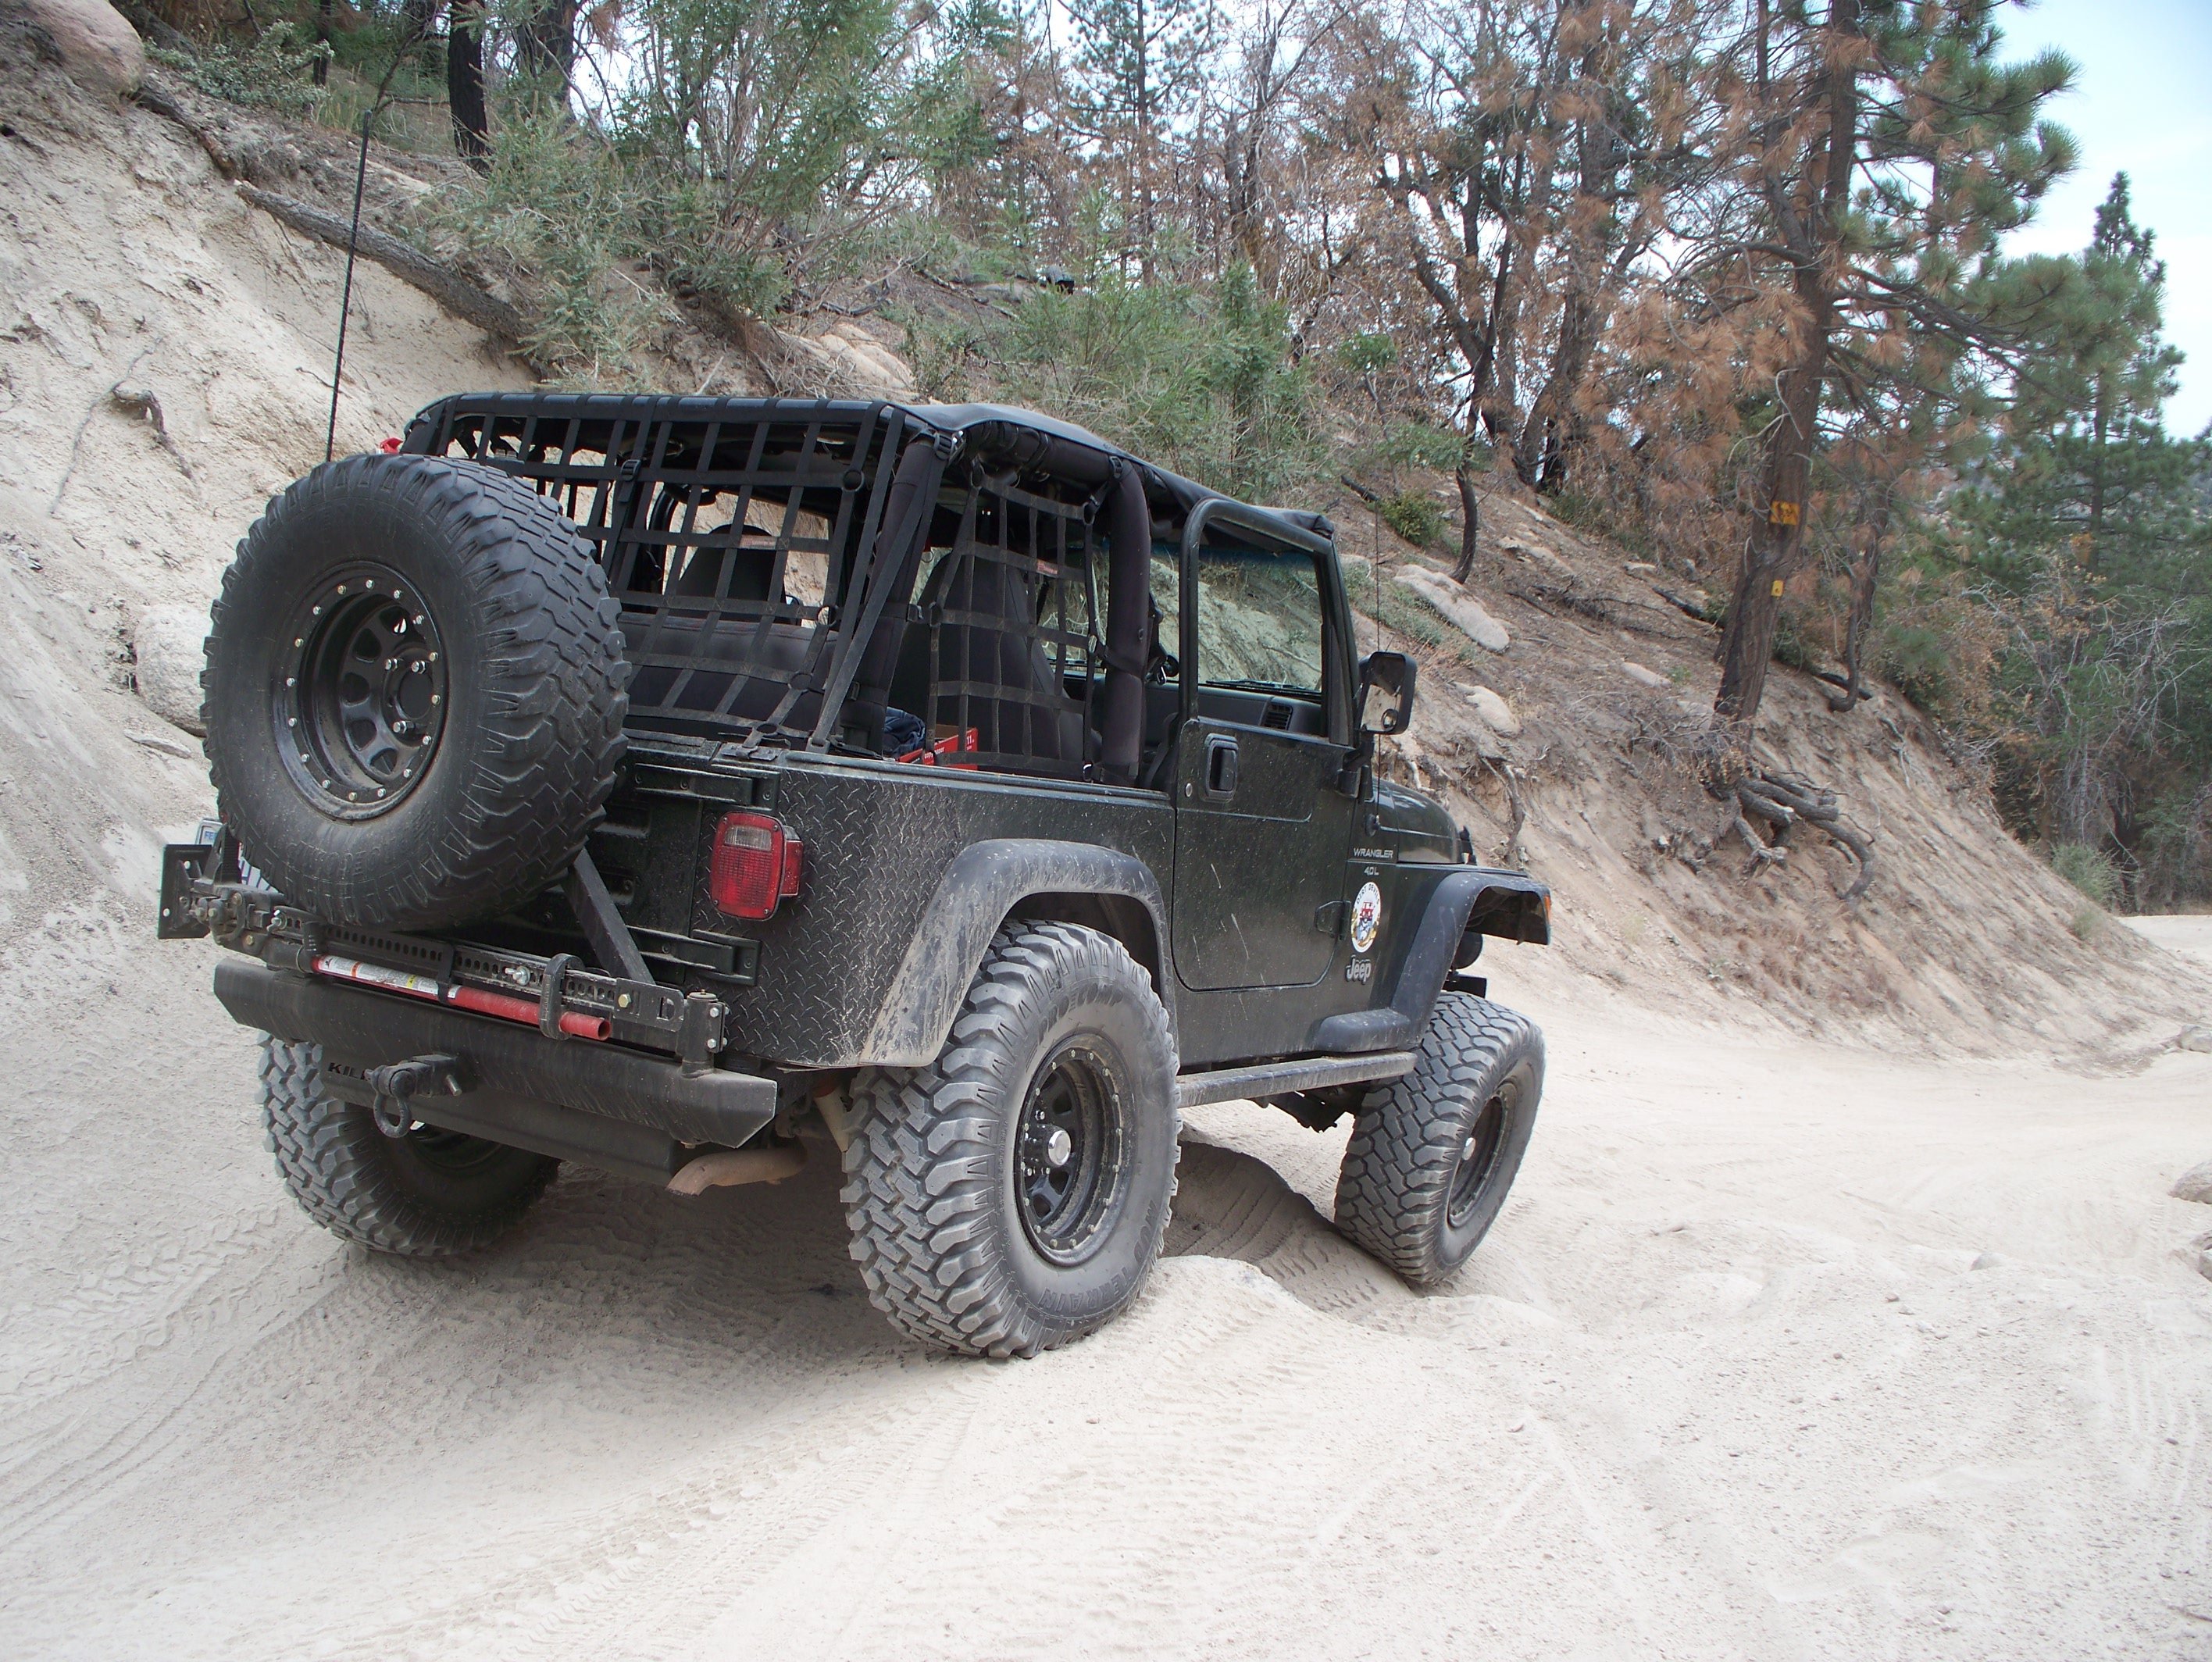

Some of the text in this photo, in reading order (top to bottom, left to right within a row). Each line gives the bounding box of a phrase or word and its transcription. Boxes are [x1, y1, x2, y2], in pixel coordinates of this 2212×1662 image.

[1354, 847, 1393, 859] WRANGLER
[1357, 886, 1367, 904] DIRT
[1346, 954, 1372, 984] Jeep
[327, 1062, 365, 1080] KIL
[1037, 1267, 1133, 1313] TERRAIN
